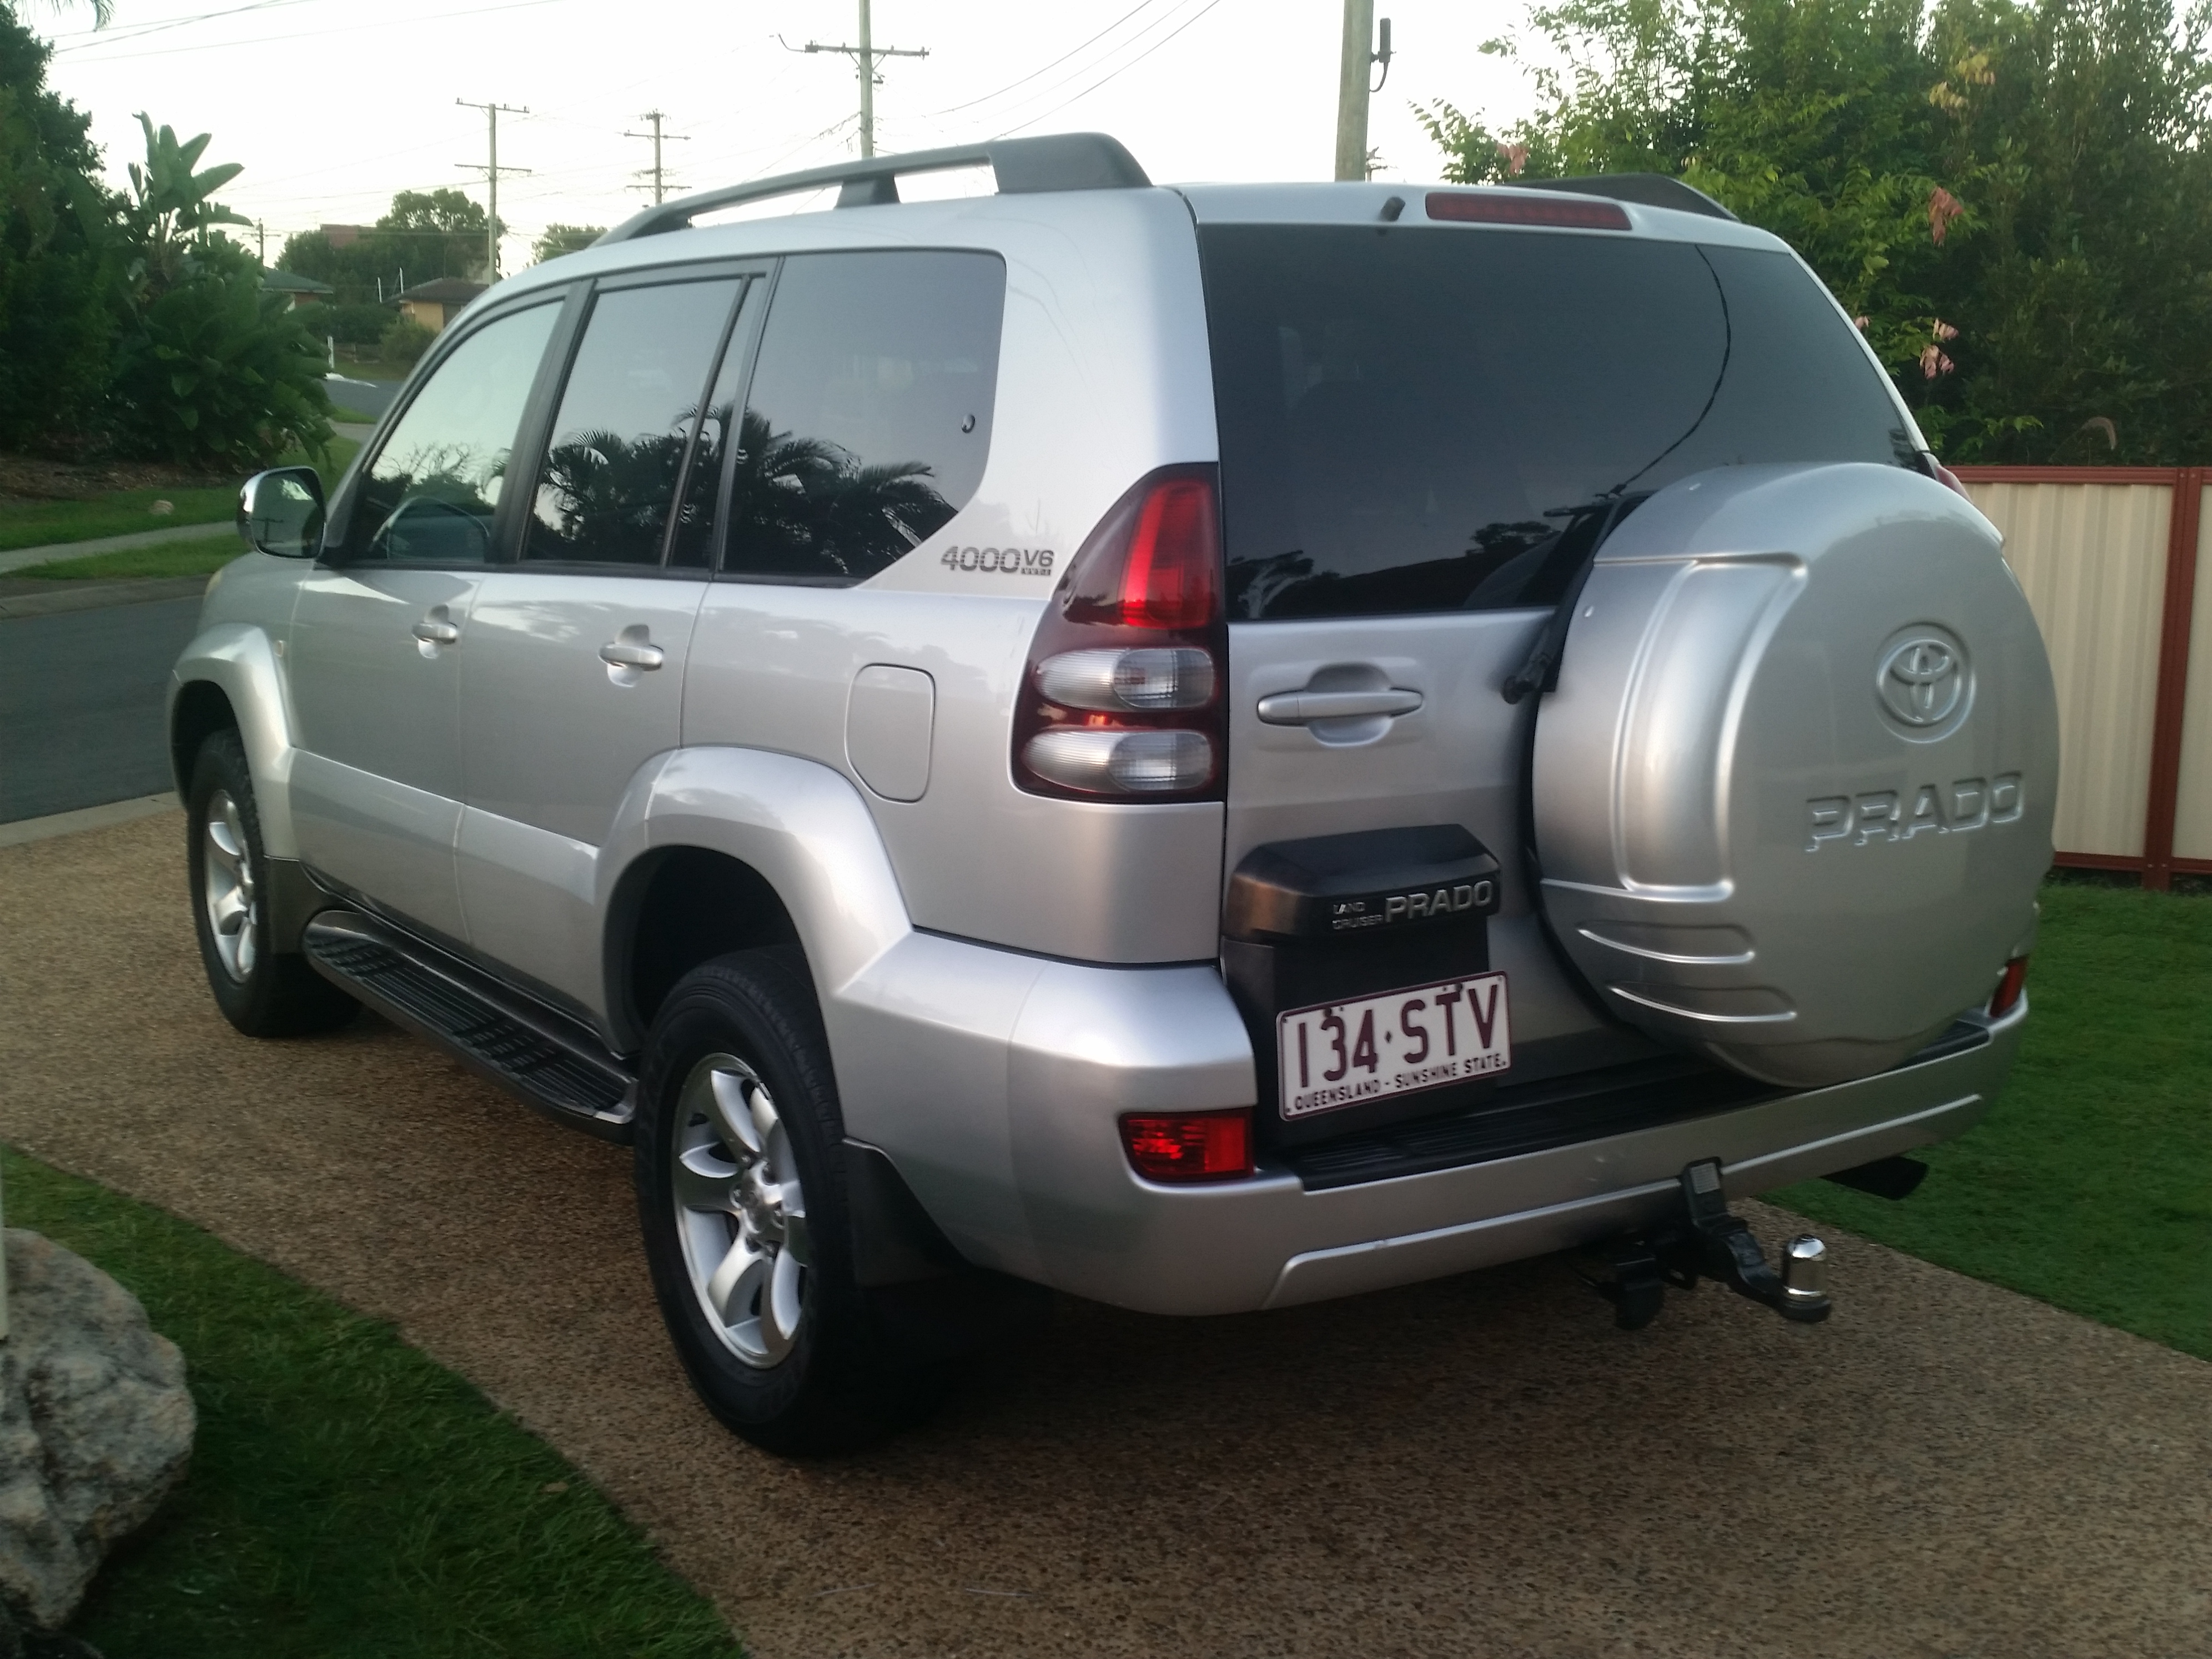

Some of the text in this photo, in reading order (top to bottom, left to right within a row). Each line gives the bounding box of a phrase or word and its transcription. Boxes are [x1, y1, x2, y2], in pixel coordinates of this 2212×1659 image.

[1806, 770, 2026, 852] PRADO
[1332, 914, 1383, 929] CRUISER
[1384, 880, 1492, 922] PRADO
[1294, 1079, 1381, 1109] QUEENSLAND
[1394, 1062, 1457, 1088] SUNSHINE
[1464, 1053, 1501, 1074] STATE
